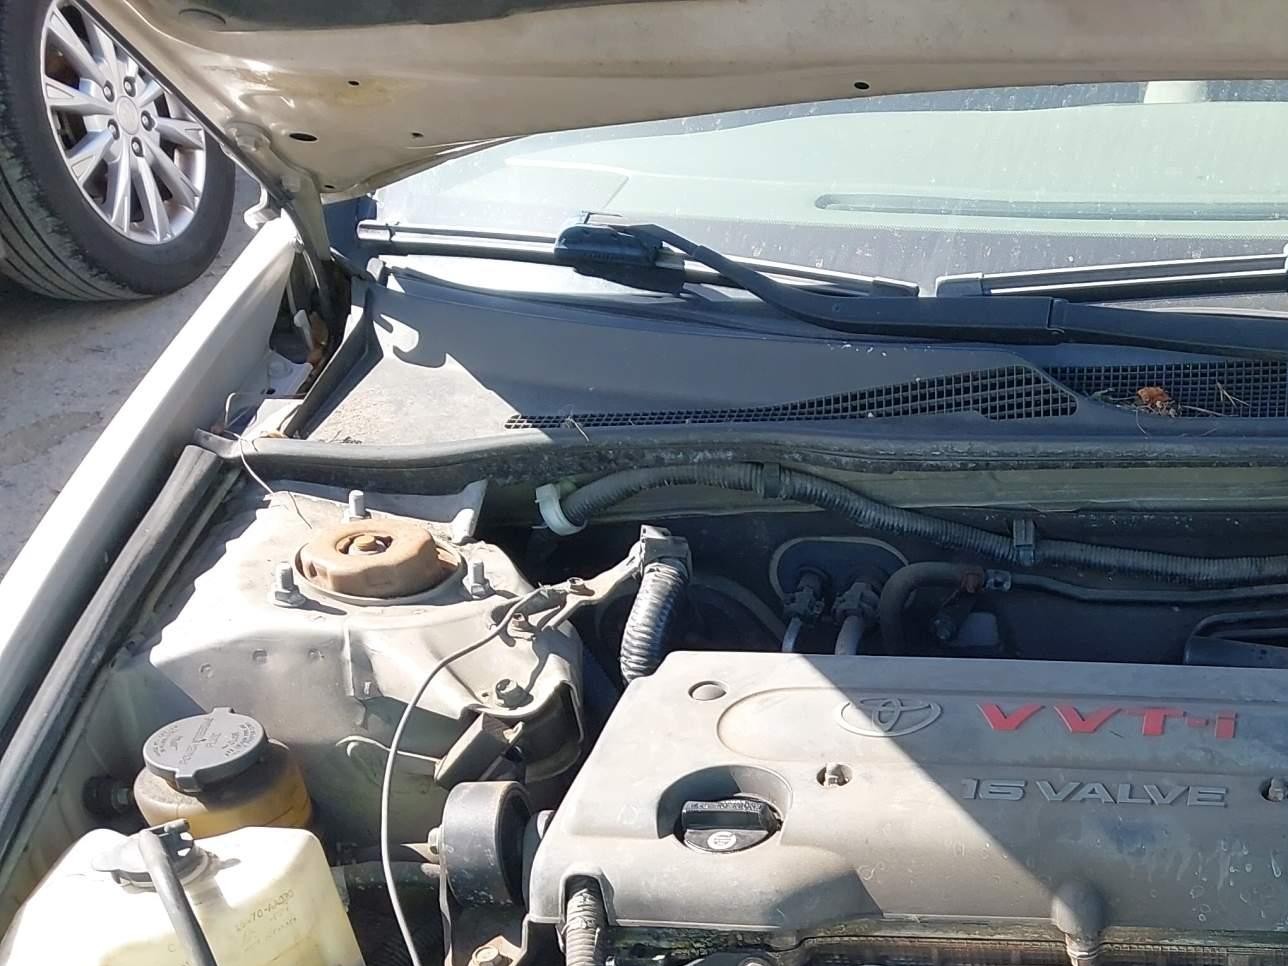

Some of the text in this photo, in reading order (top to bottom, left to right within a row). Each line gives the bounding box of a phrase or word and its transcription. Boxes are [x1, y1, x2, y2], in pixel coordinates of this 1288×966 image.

[977, 703, 1239, 739] VVT-i
[961, 778, 1228, 808] 16 VALVE
